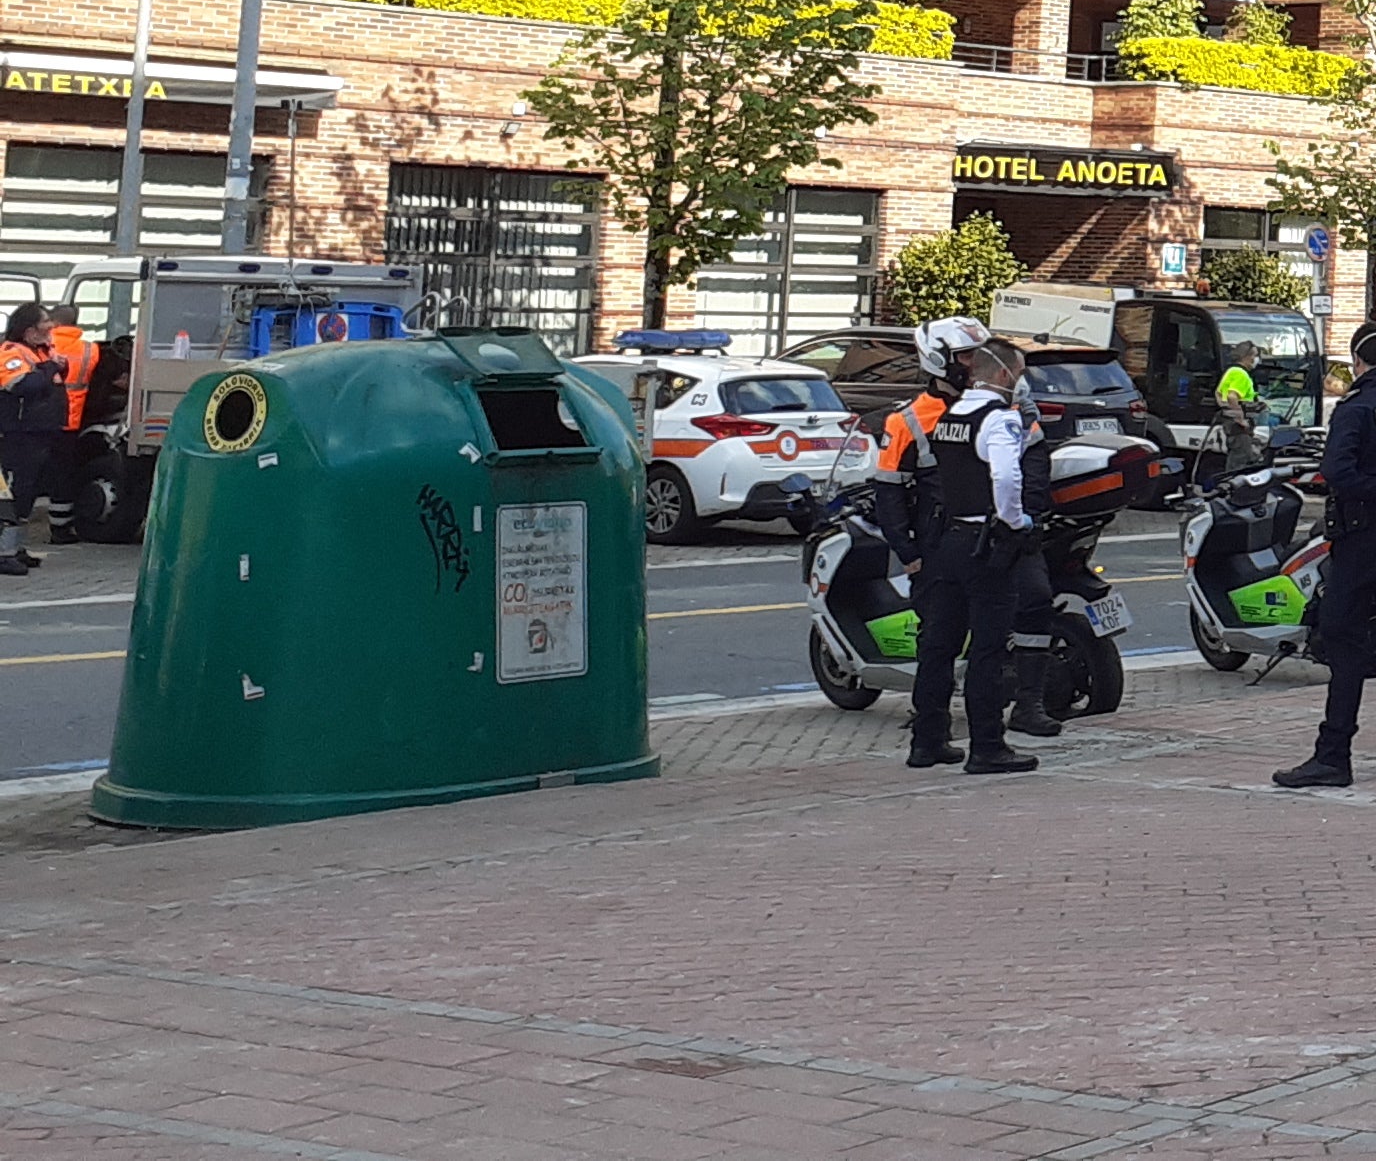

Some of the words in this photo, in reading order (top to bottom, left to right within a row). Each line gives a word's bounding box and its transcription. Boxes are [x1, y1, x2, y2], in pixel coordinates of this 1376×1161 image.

[954, 155, 1045, 181] HOTEL
[1057, 159, 1168, 186] ANOETA
[933, 422, 971, 443] POLIZIA
[1093, 596, 1123, 617] 7024
